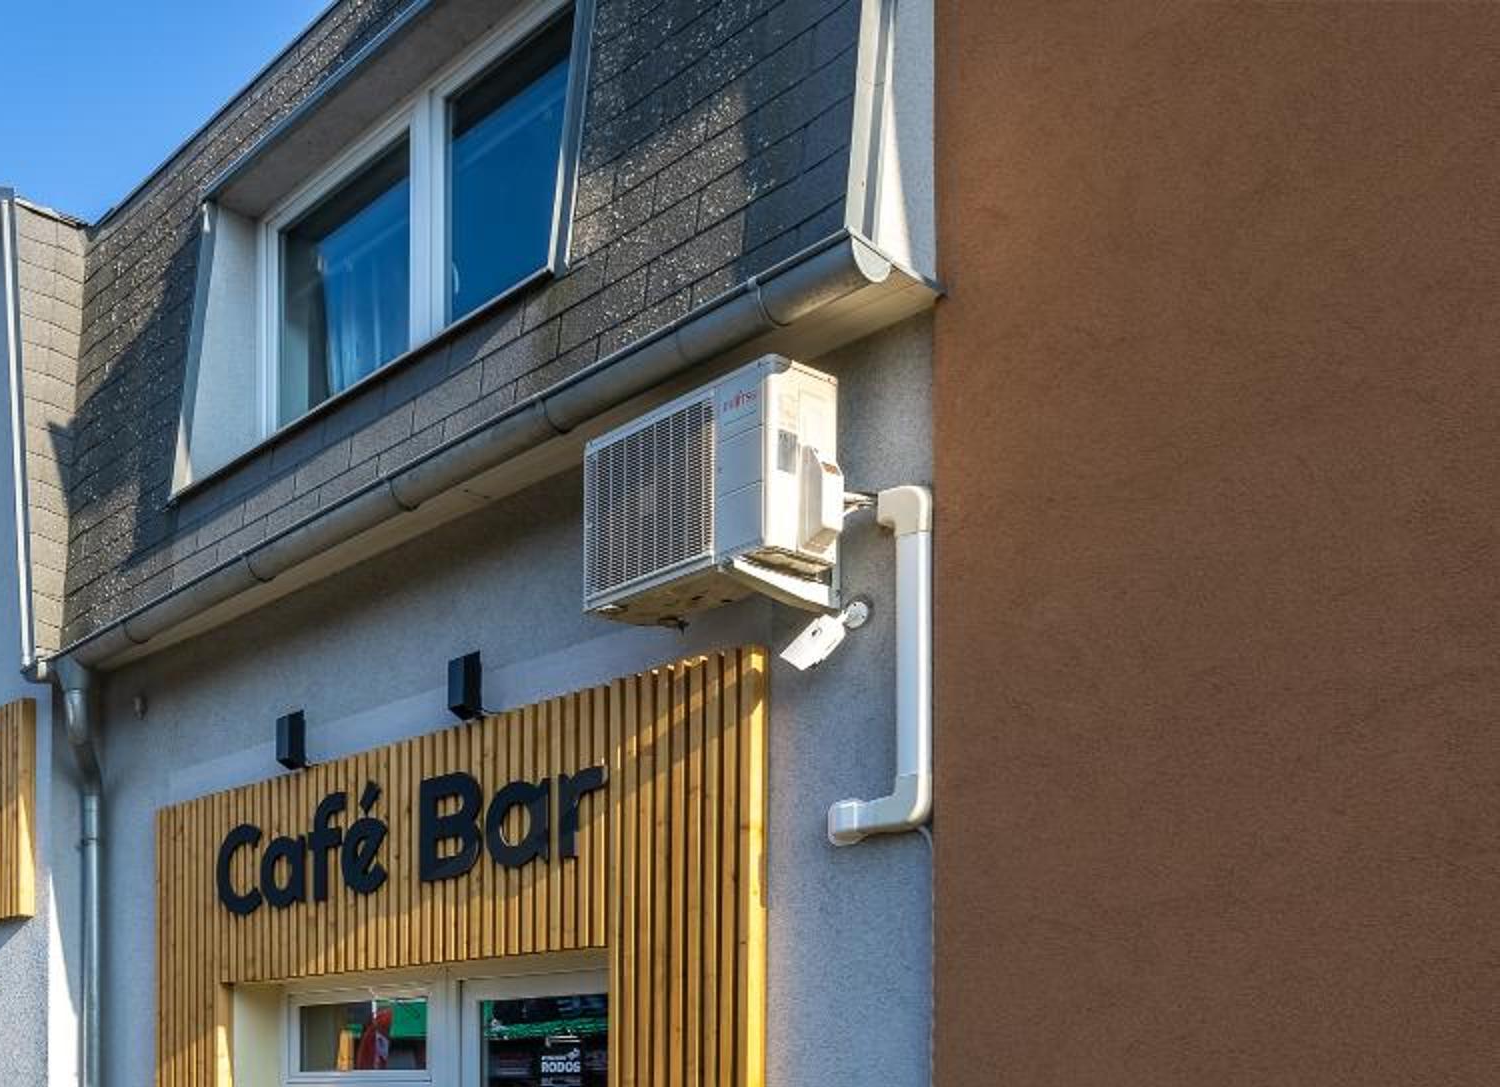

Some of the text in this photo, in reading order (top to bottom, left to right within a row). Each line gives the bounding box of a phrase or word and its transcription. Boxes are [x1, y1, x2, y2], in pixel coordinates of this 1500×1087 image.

[216, 765, 609, 916] Café Bar
[541, 1061, 580, 1072] RODOS
